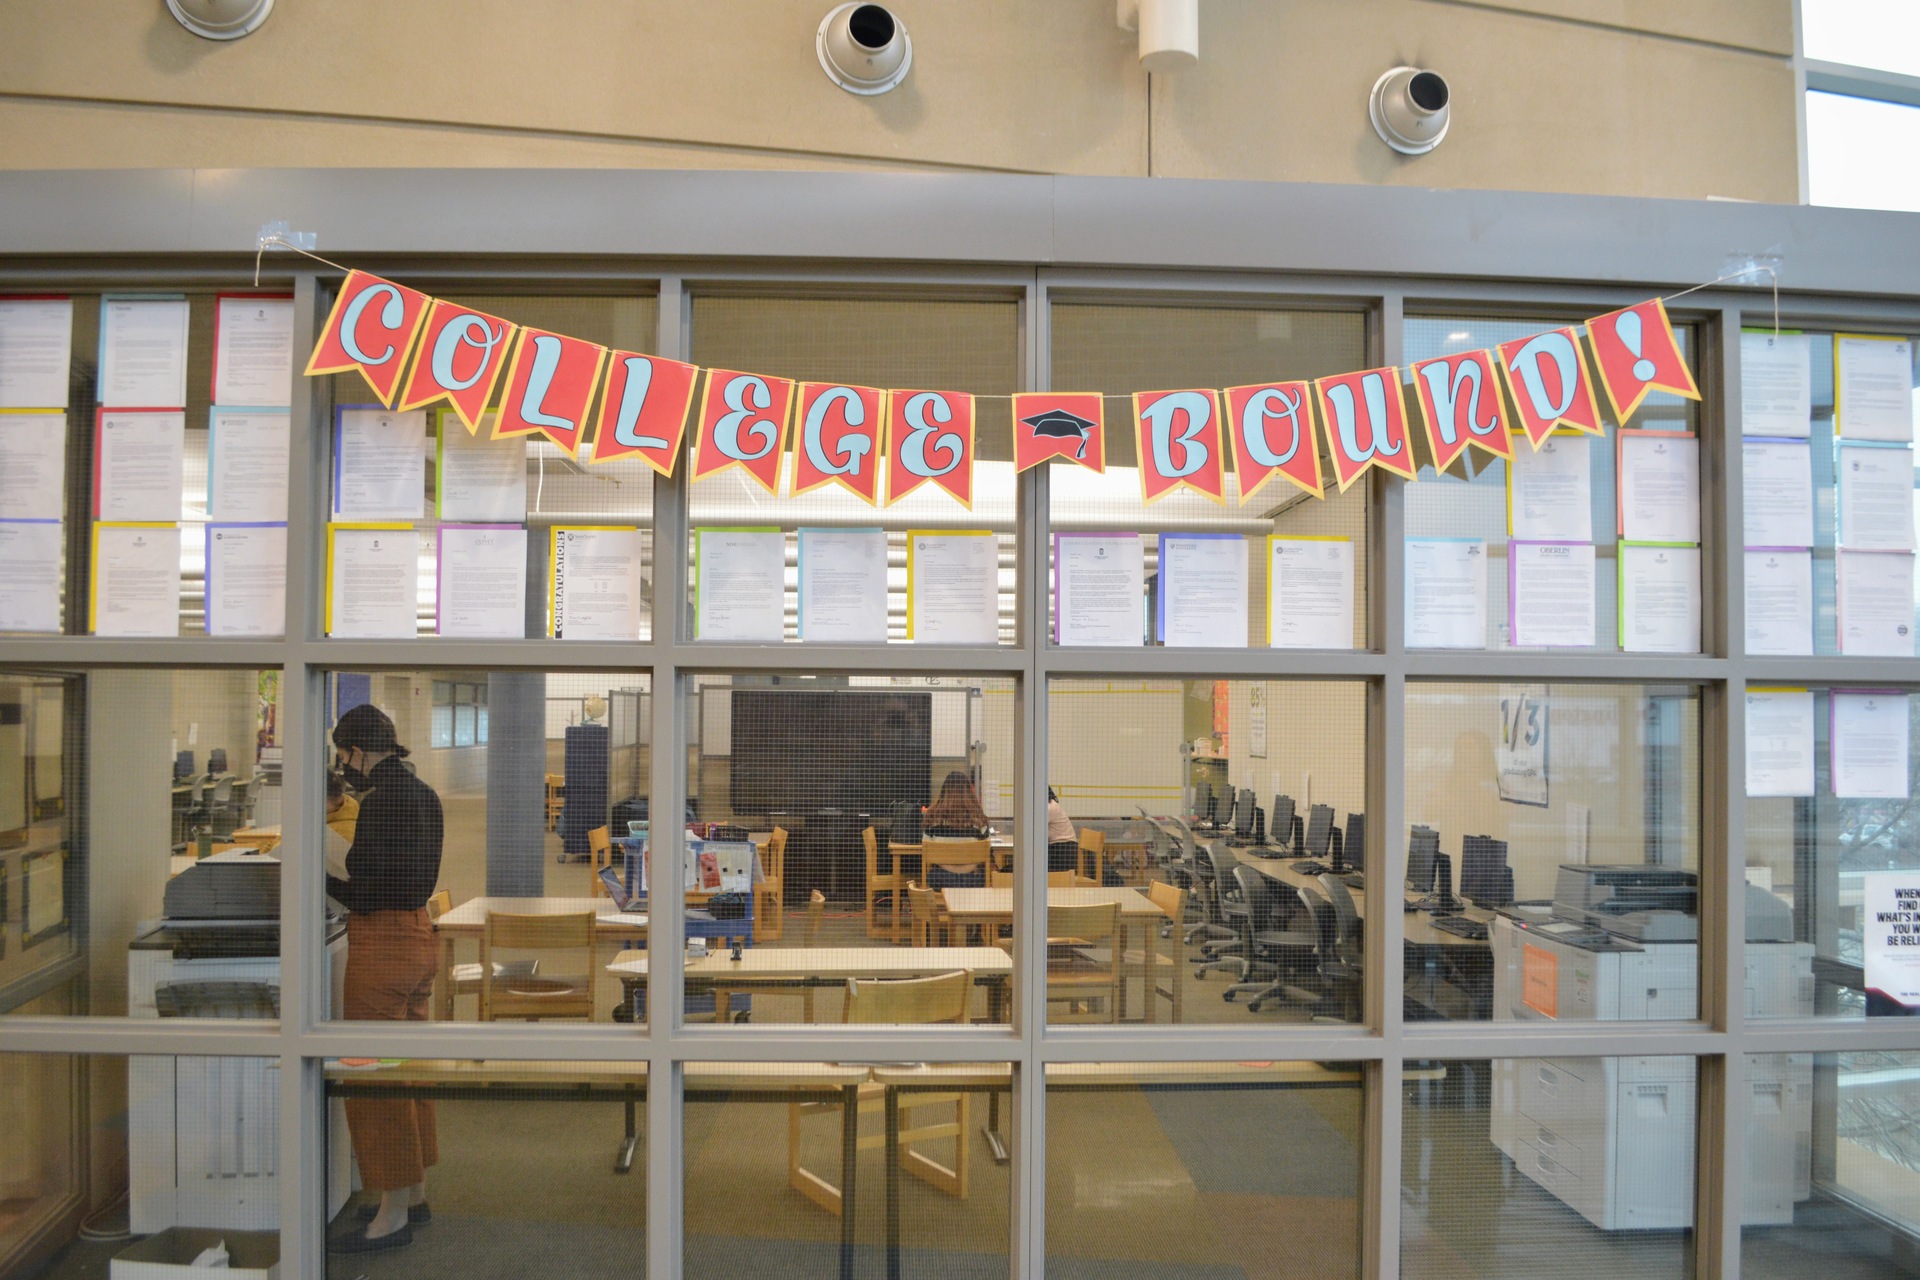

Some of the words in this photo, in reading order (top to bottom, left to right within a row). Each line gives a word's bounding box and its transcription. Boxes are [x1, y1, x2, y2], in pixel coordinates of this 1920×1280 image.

[338, 283, 964, 478] COLLEGE
[1140, 309, 1658, 479] BOUND!
[1539, 546, 1570, 554] OBERLIN
[555, 530, 565, 632] CONGRATULATIONS
[1500, 693, 1541, 752] 1/3
[1897, 900, 1917, 911] FIND
[1876, 912, 1911, 923] WHAT'S
[1892, 924, 1910, 934] YOU
[1887, 935, 1898, 946] BE
